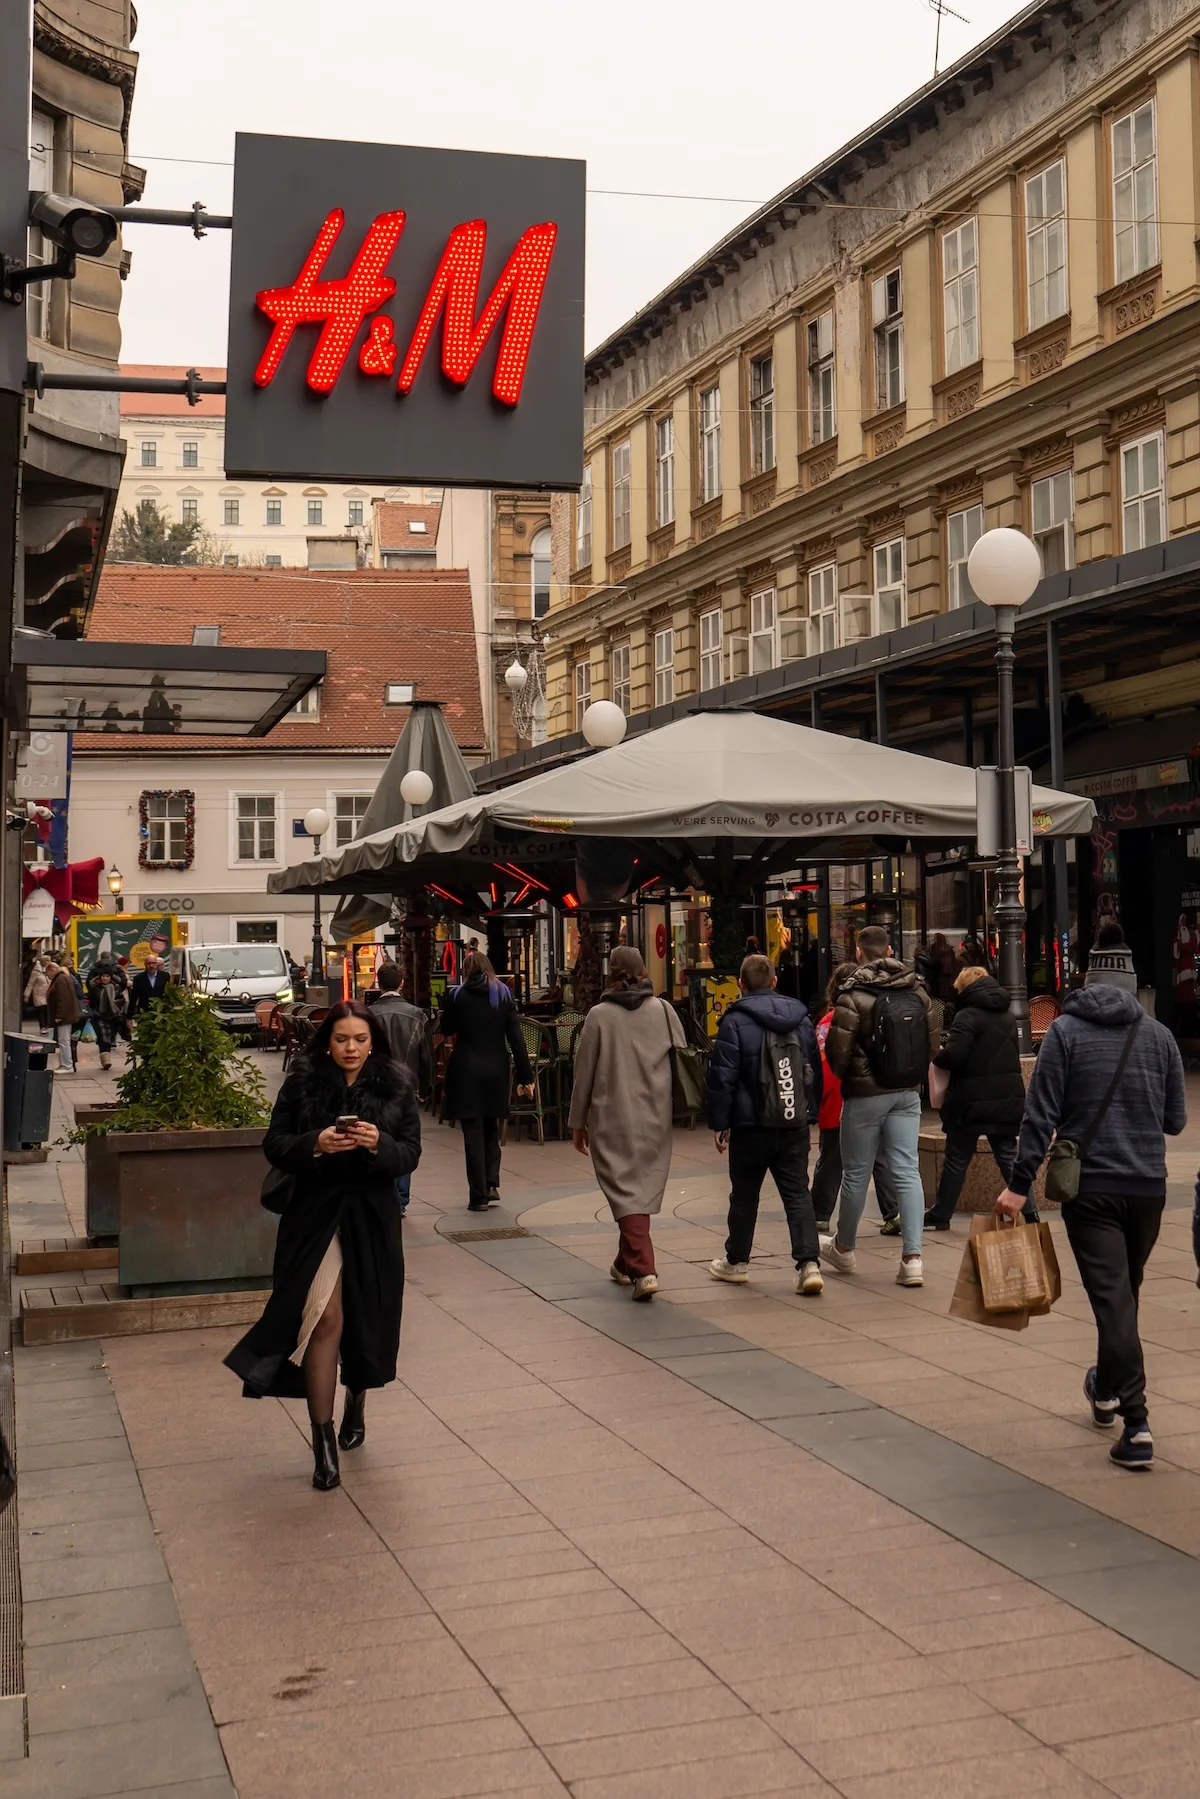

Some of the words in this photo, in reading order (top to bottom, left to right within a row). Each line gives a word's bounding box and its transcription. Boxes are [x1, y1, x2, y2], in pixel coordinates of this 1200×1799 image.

[254, 207, 558, 408] H&M
[672, 816, 707, 827] WE'RE
[710, 815, 756, 827] SERVING
[788, 811, 848, 827] COSTA
[855, 809, 925, 825] COFFEE
[469, 842, 520, 858] COSTA
[143, 897, 195, 912] ecco
[1089, 955, 1127, 970] UMA
[778, 1056, 796, 1121] adidas
